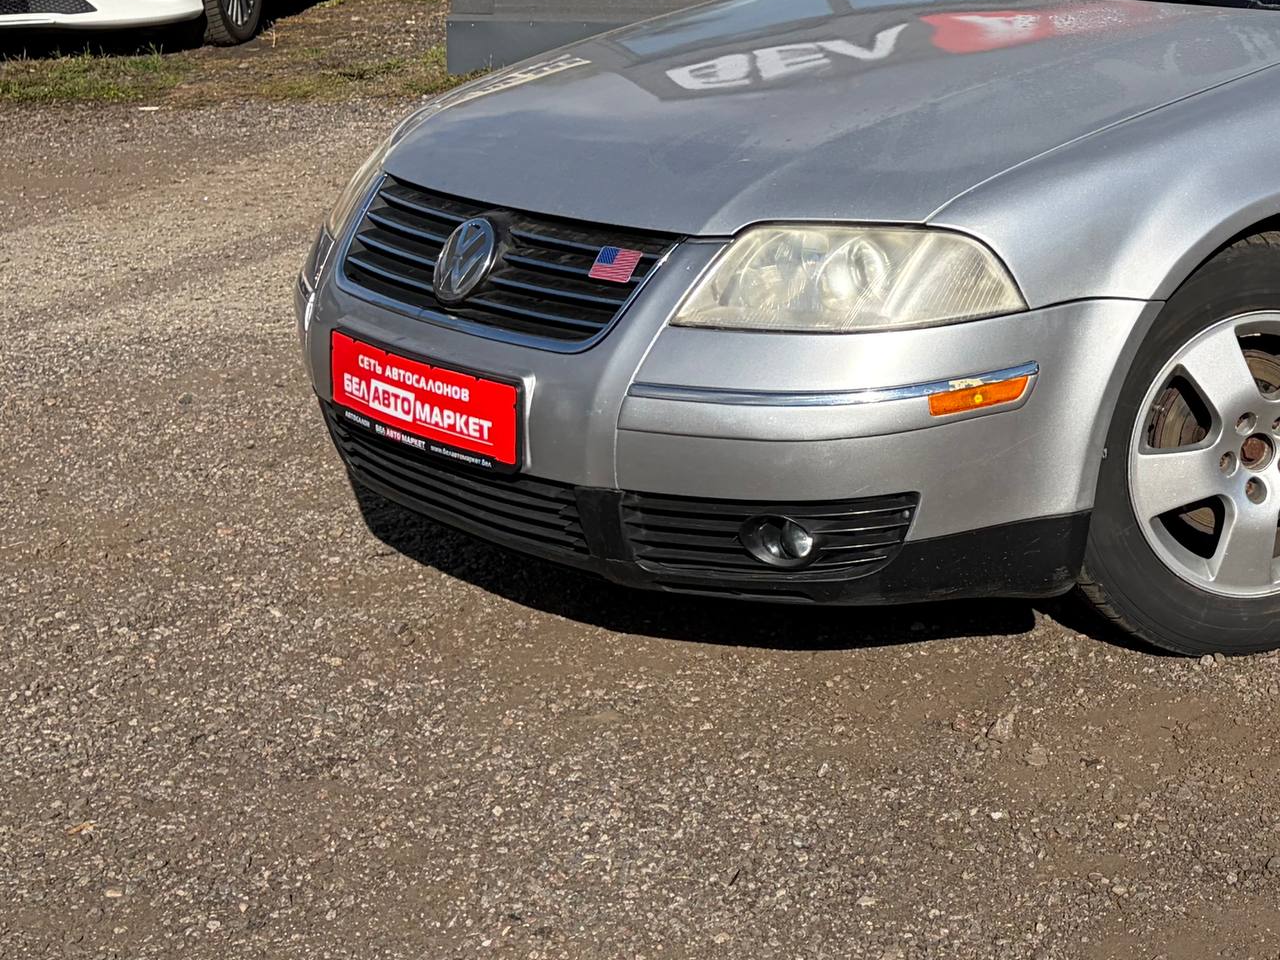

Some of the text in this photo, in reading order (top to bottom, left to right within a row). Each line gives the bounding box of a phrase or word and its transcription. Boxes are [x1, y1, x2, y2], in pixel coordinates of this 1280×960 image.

[358, 353, 470, 402] СЕТЬ АВТОСАЛОНОВ
[343, 372, 493, 441] БЕЛ АВТО МАРКЕТ
[401, 434, 426, 449] МАРКЕТ
